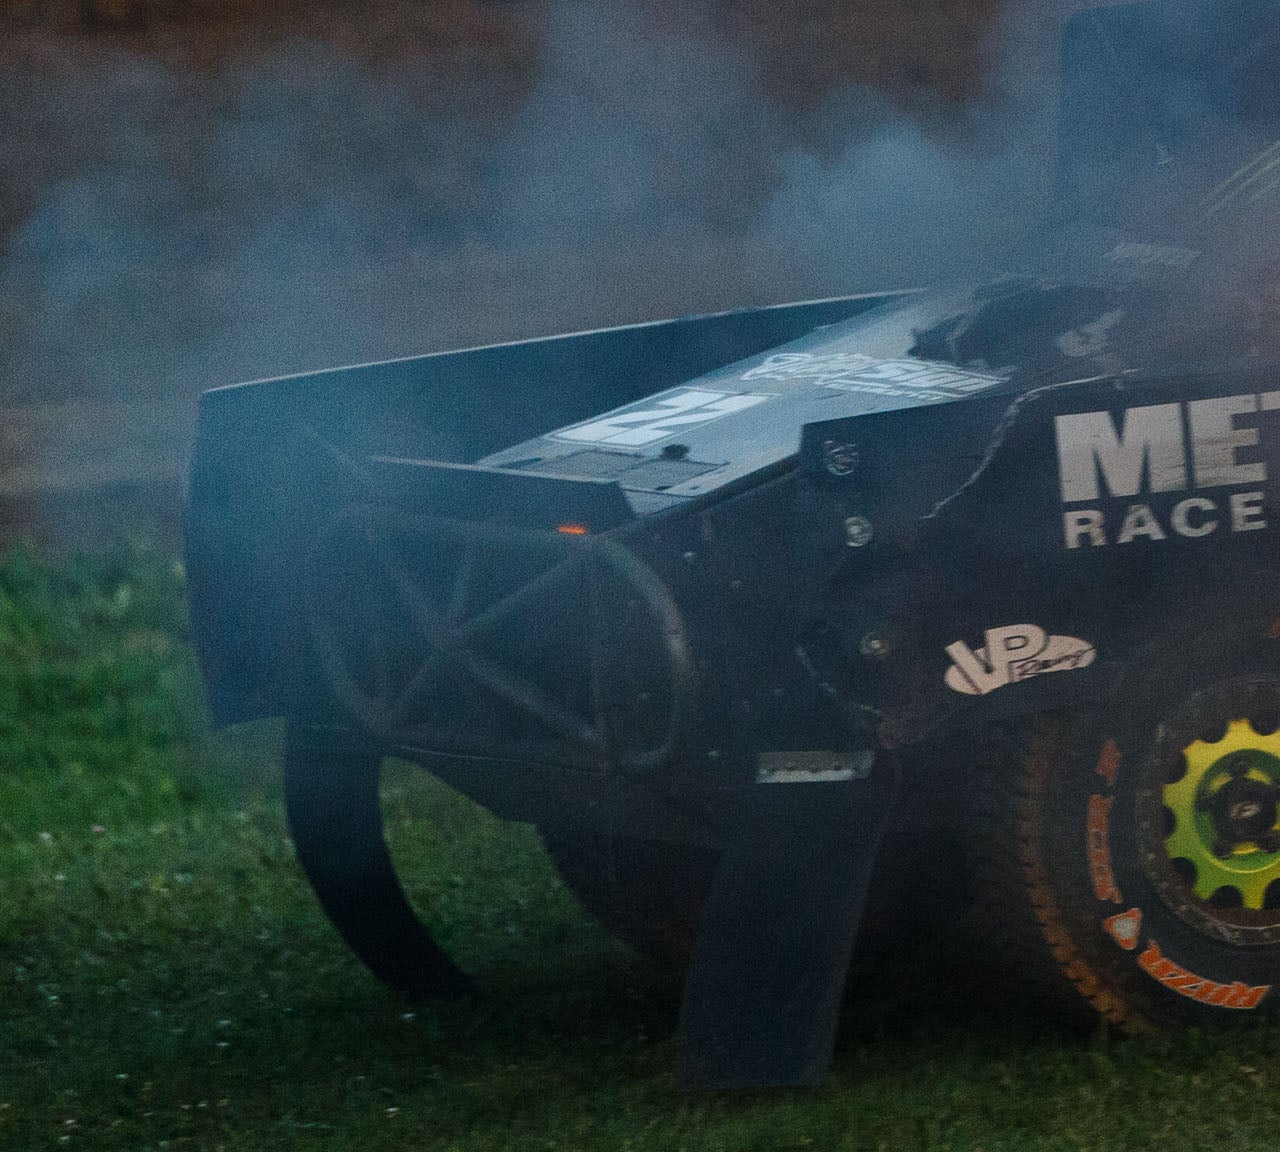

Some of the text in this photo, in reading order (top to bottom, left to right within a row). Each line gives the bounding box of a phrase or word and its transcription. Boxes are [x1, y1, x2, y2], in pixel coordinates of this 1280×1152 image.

[556, 389, 773, 447] 22
[1063, 491, 1269, 549] RACE
[944, 623, 1048, 696] VP
